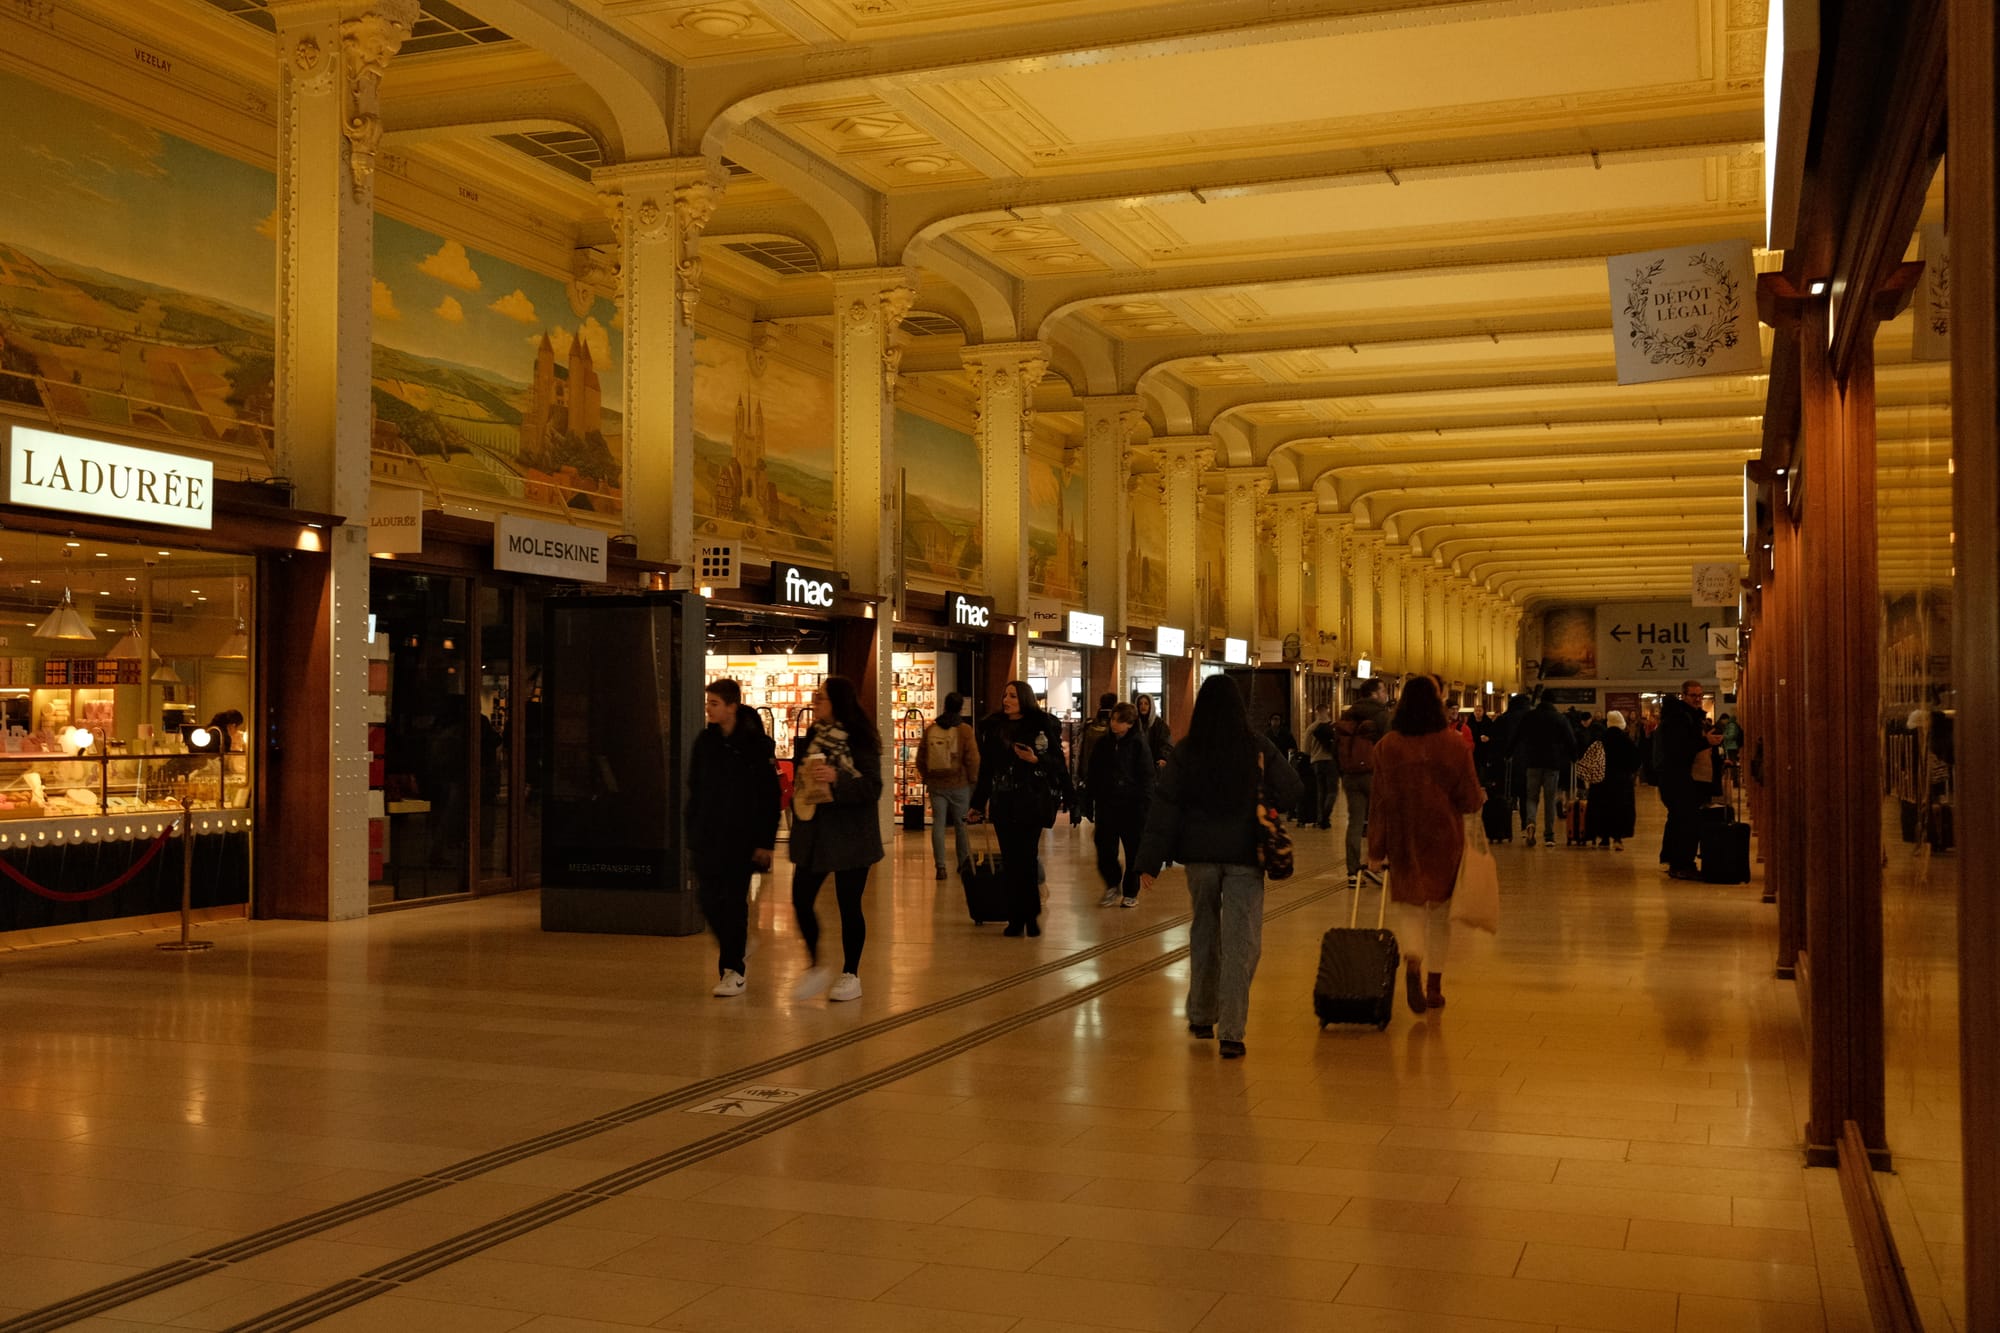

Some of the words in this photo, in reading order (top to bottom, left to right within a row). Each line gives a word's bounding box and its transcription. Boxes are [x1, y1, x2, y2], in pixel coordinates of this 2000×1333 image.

[134, 47, 172, 72] VEZELAY
[1654, 285, 1712, 306] DÉPÔT
[1657, 303, 1713, 322] LÉGAL
[21, 449, 204, 510] LADURÉE
[370, 515, 416, 527] LADURÉE
[508, 535, 600, 565] MOLESKINE
[785, 567, 834, 609] fnac
[955, 595, 989, 628] fnac
[1033, 611, 1058, 620] fnac
[1637, 623, 1690, 644] Hall
[1641, 656, 1653, 668] A
[1672, 655, 1685, 668] N
